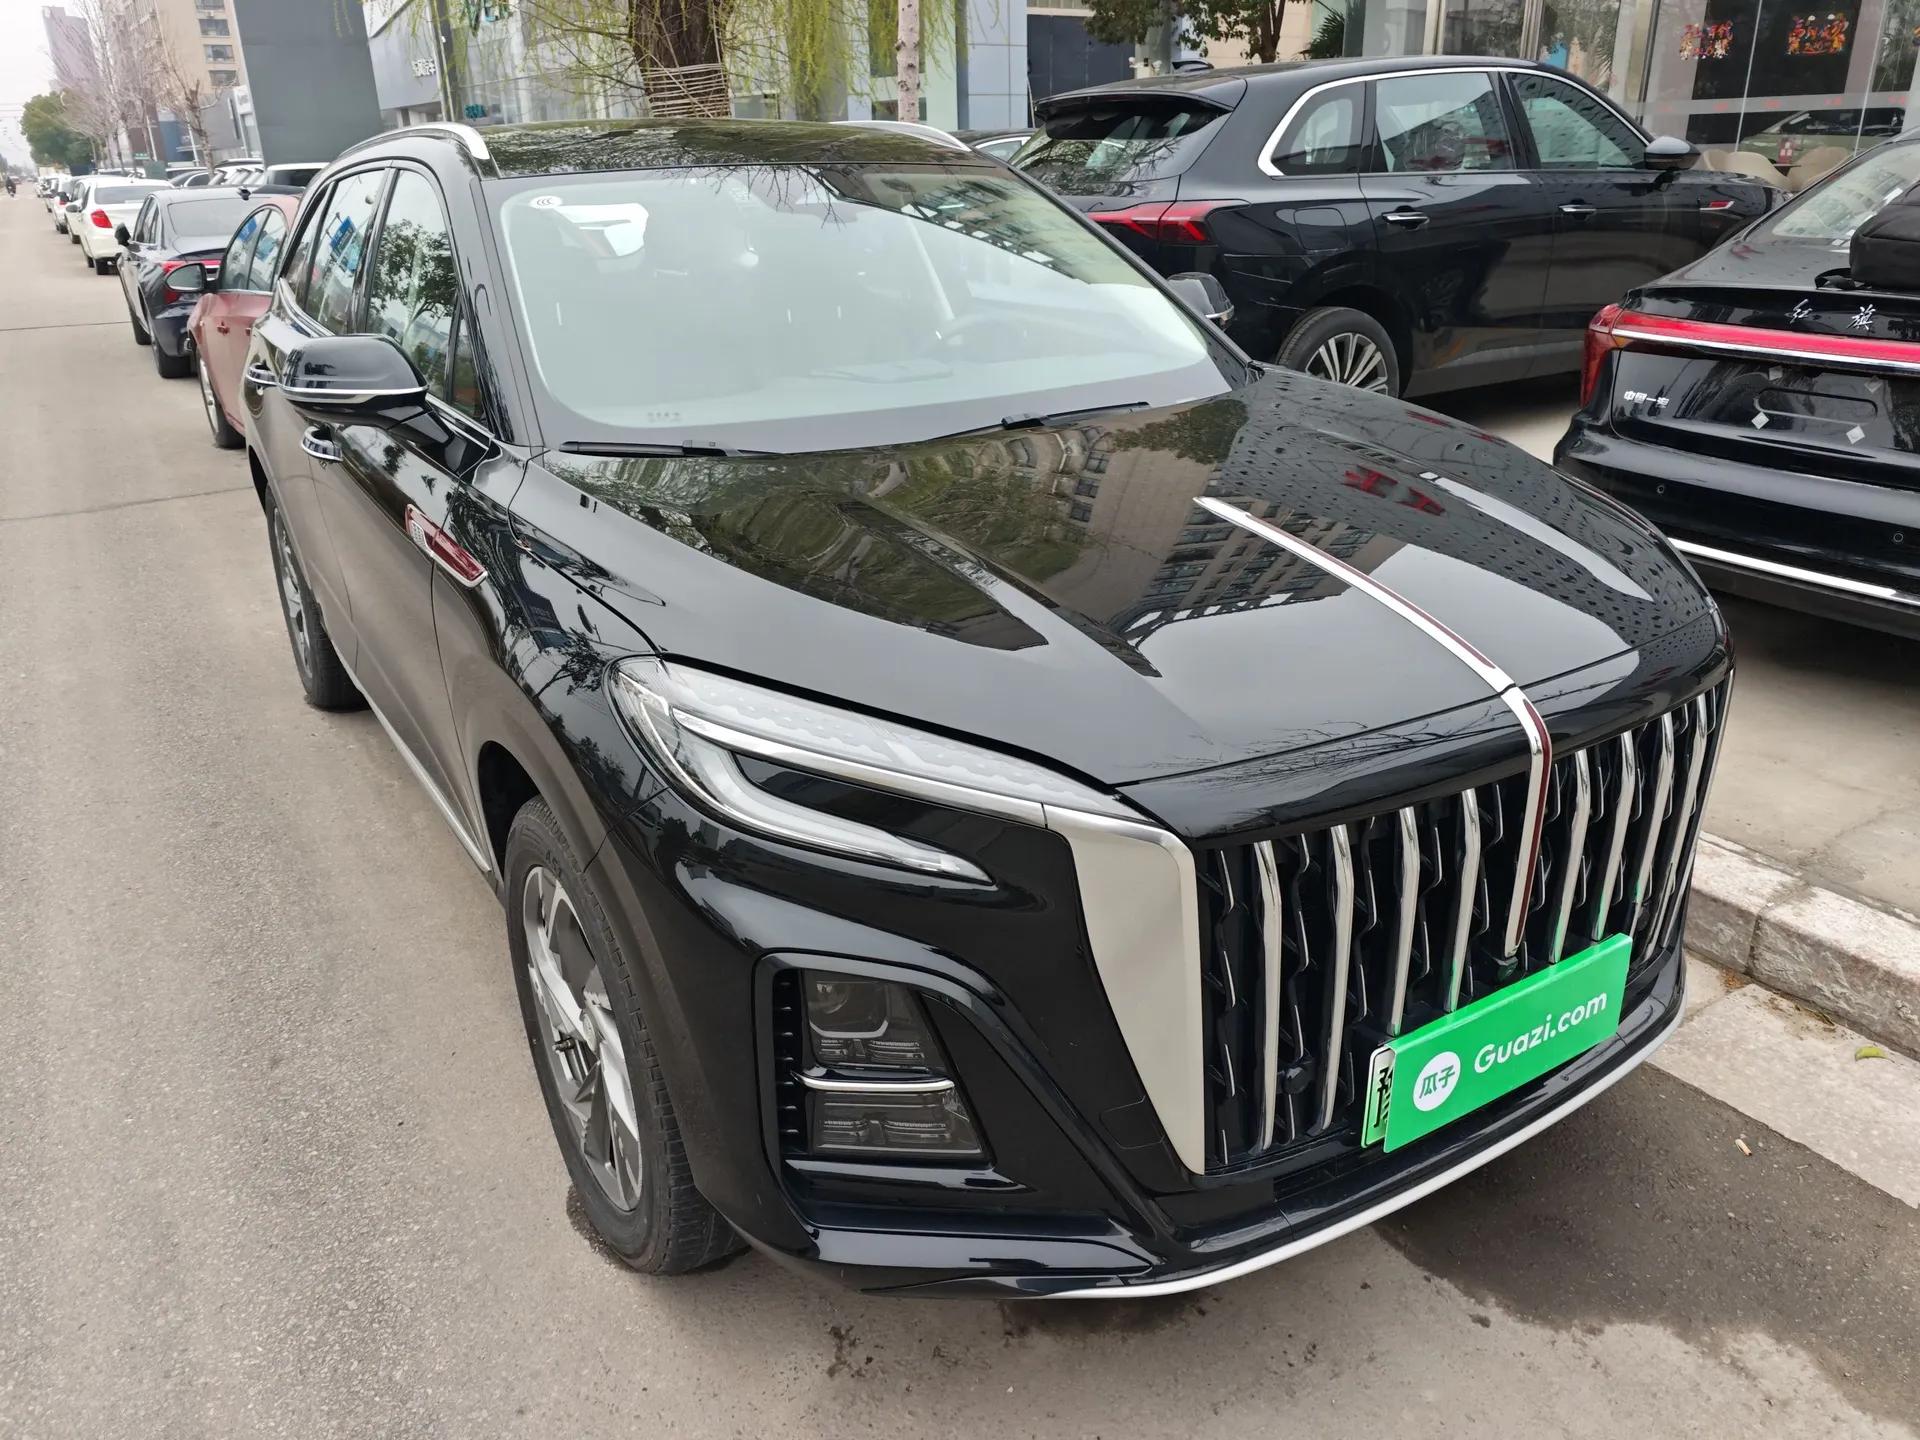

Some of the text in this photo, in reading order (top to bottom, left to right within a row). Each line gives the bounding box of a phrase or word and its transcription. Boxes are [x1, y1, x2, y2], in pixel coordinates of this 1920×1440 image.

[1789, 298, 1876, 331] 红旗
[1474, 992, 1608, 1074] Guazi.com
[1418, 1064, 1456, 1100] 瓜子
